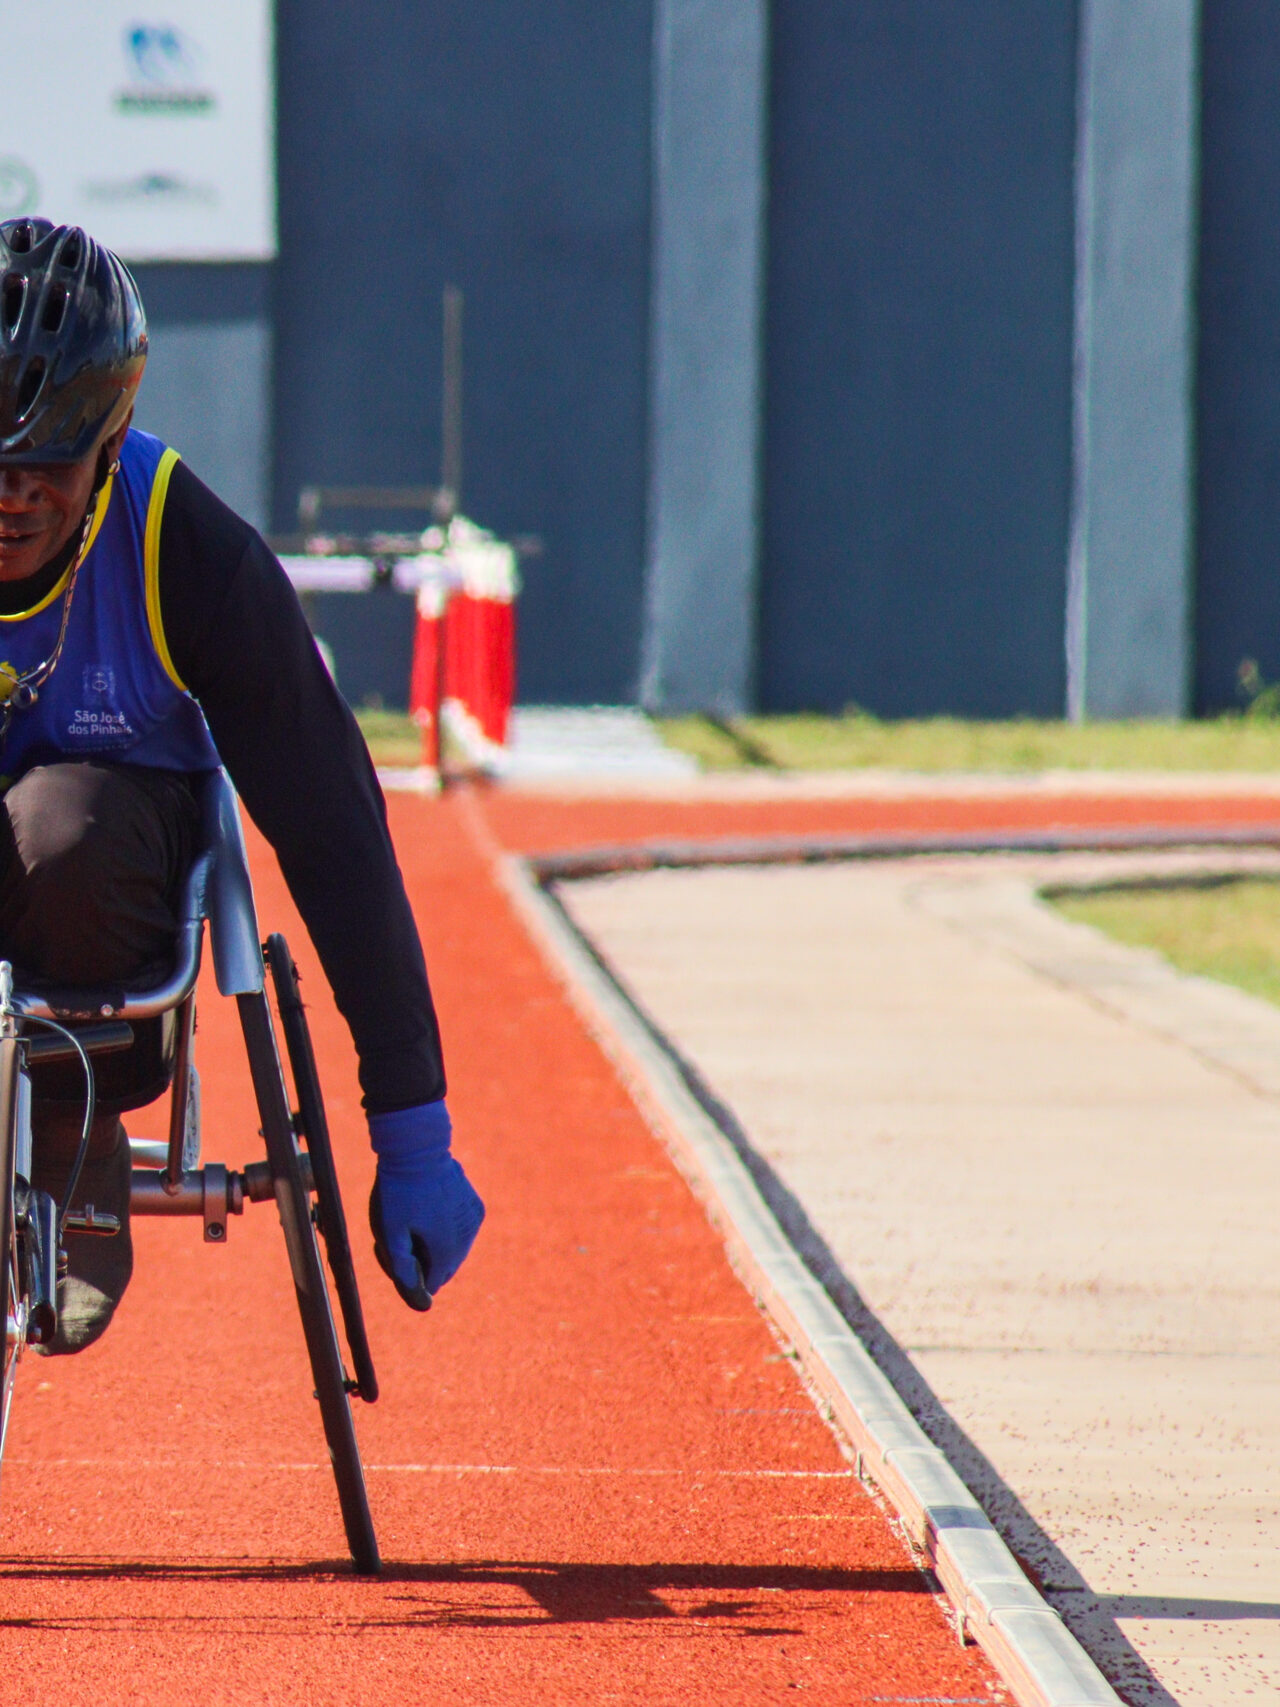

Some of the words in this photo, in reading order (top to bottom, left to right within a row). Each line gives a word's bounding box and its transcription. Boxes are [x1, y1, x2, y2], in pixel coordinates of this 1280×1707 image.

[74, 710, 98, 723] São
[100, 711, 125, 725] José
[67, 723, 89, 735] dos
